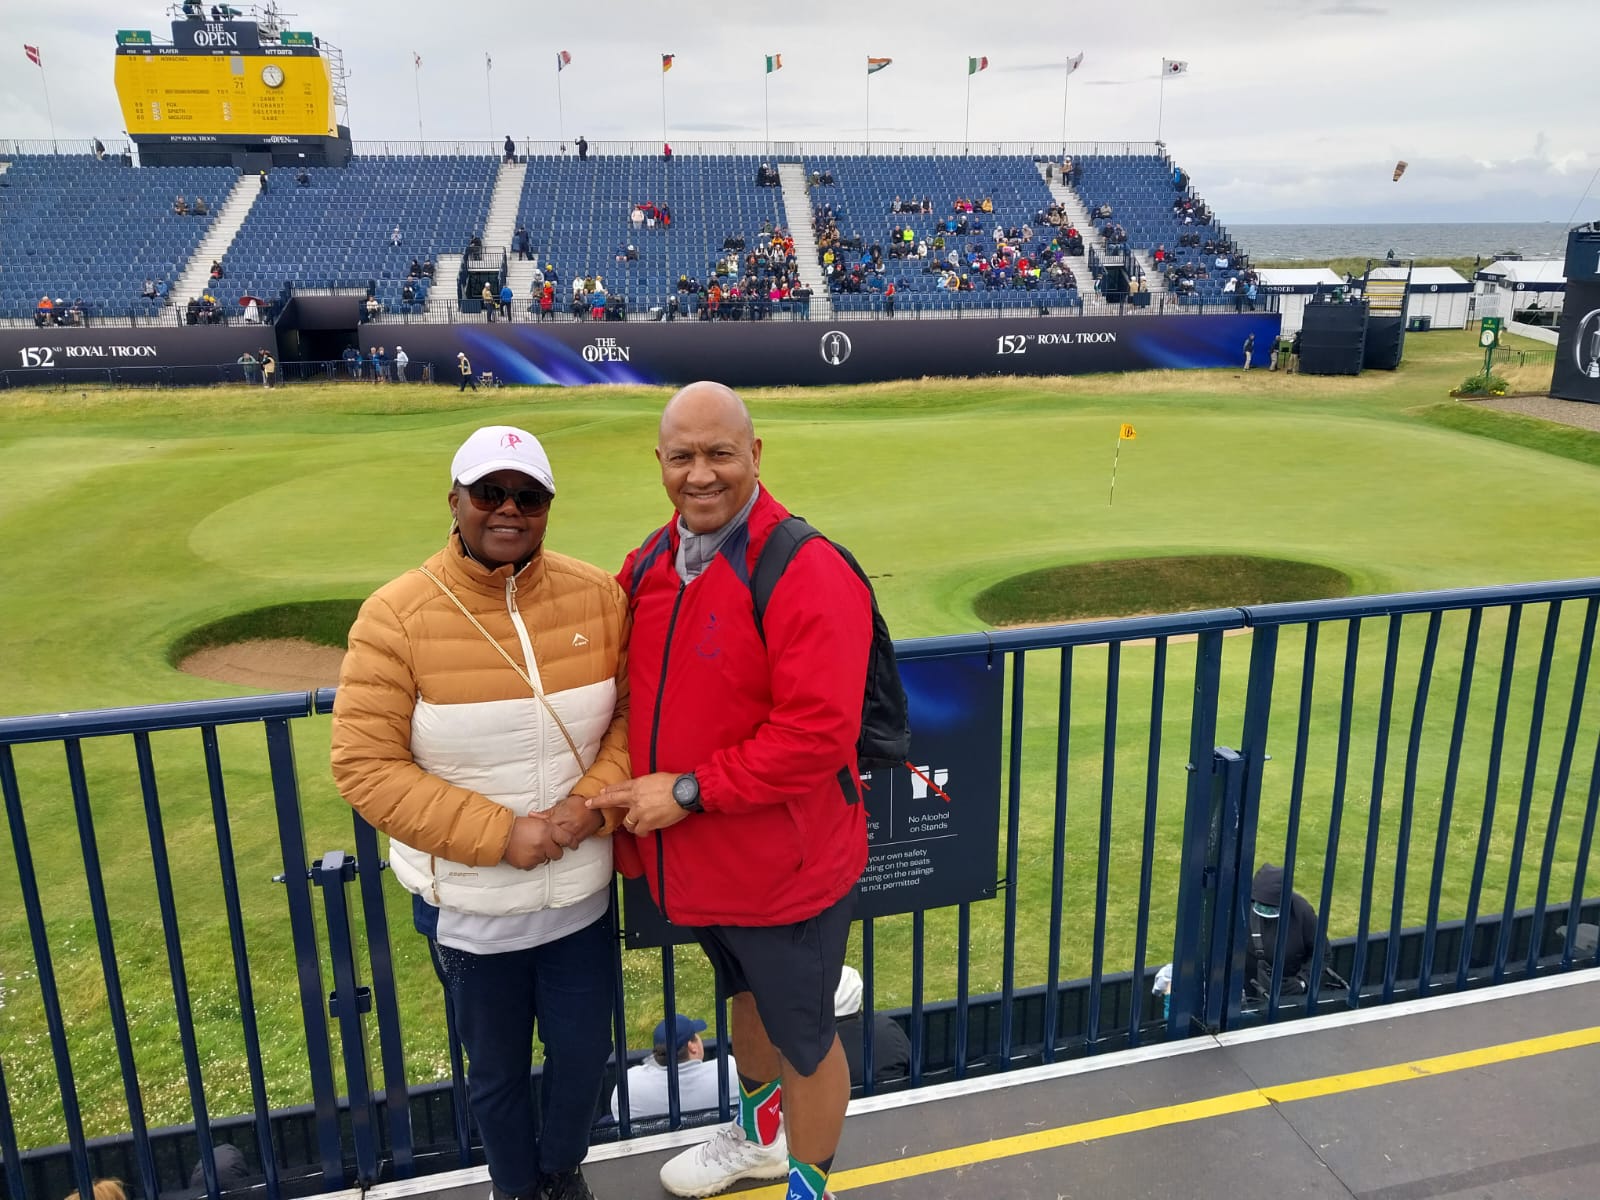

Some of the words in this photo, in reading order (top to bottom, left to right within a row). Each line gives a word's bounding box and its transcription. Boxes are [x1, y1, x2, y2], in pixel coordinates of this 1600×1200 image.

[205, 23, 224, 31] THE
[194, 30, 237, 46] OPEN
[595, 337, 617, 347] THE
[1038, 334, 1073, 344] ROYAL
[1075, 333, 1117, 343] TROON
[66, 346, 108, 357] ROYAL
[109, 345, 157, 356] TROON
[582, 344, 630, 362] OPEN
[921, 812, 950, 821] Alcohol
[921, 822, 948, 832] Stands
[868, 855, 885, 864] your
[903, 849, 927, 859] safety
[863, 865, 884, 873] nding
[896, 860, 909, 868] the
[910, 858, 930, 866] seats
[857, 874, 882, 882] aning
[894, 870, 907, 878] the
[907, 866, 934, 876] railings
[869, 881, 882, 890] not
[883, 878, 920, 890] permitted
